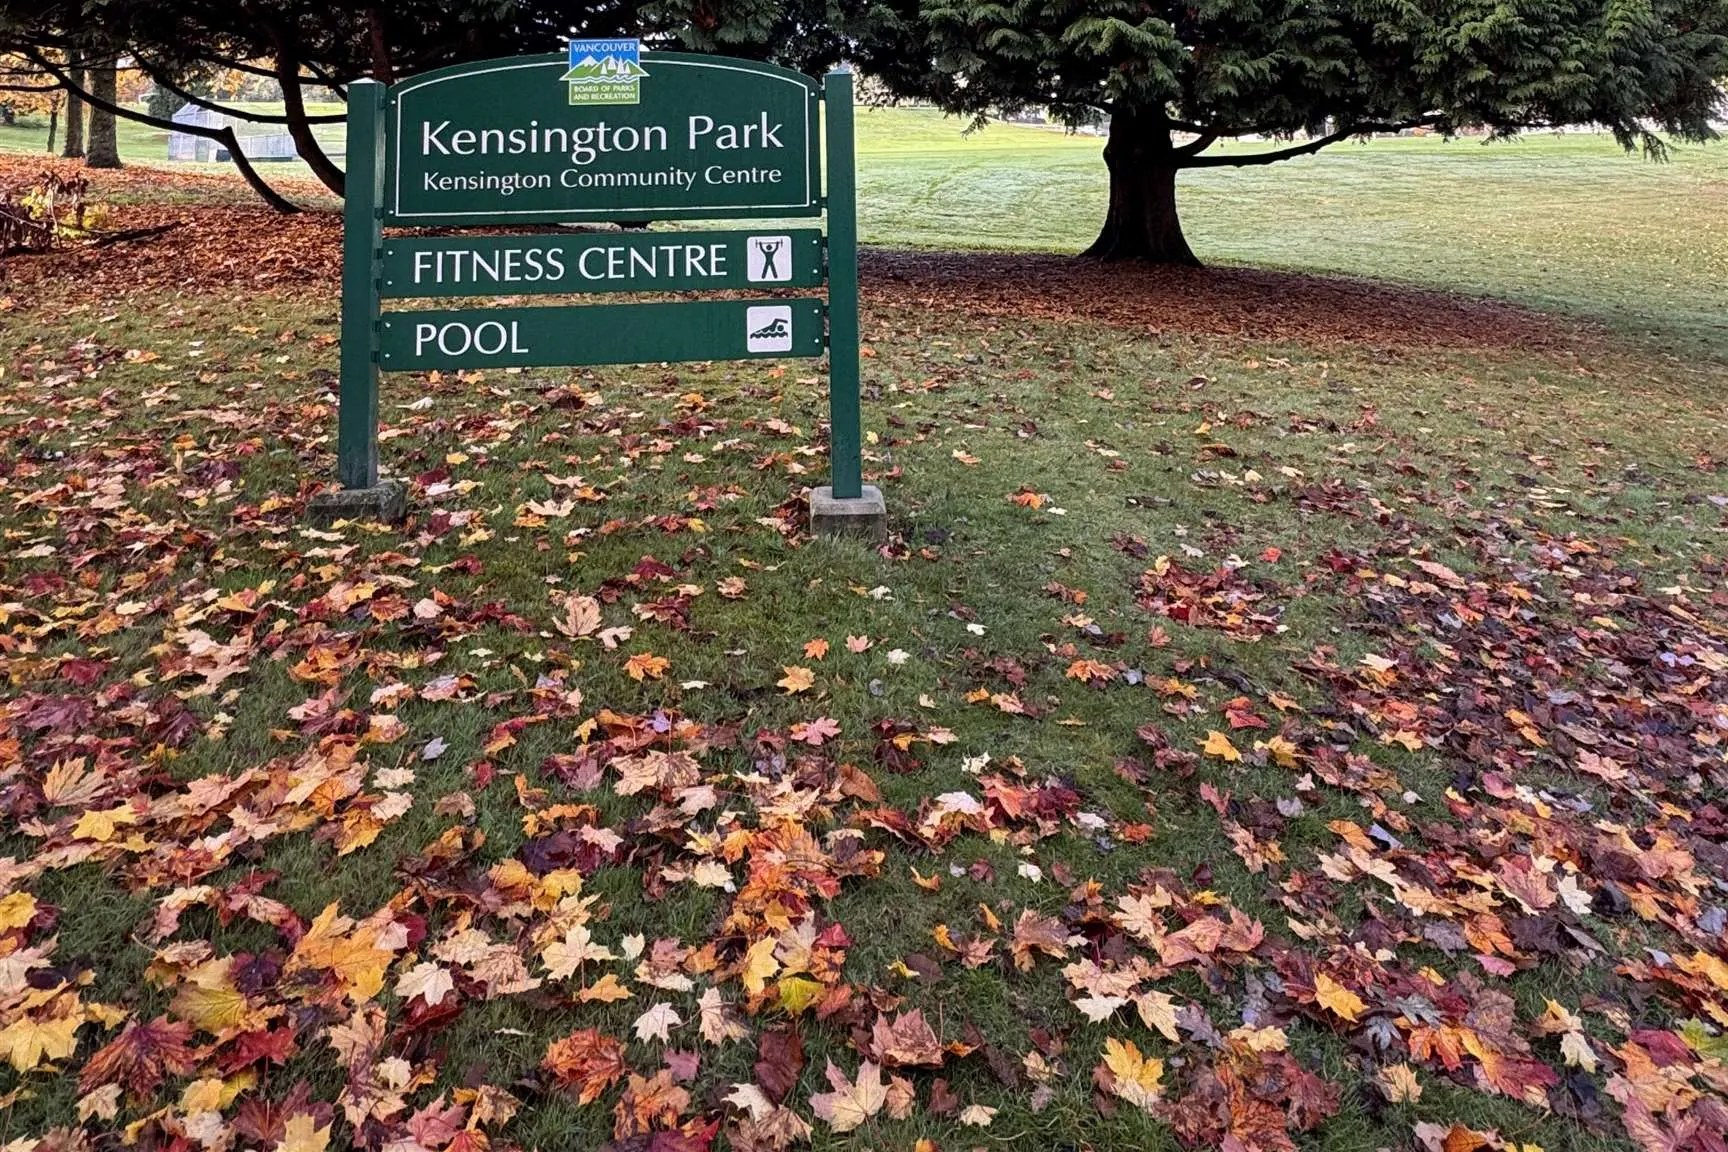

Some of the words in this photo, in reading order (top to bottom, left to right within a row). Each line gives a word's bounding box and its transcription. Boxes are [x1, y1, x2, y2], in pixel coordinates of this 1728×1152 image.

[574, 43, 635, 52] VANCOUVER
[421, 119, 668, 166] Kensington
[688, 111, 785, 150] Park
[423, 170, 551, 195] Kensington
[560, 167, 697, 192] Community
[704, 164, 783, 186] Centre
[413, 247, 565, 284] FITNESS
[578, 243, 728, 280] CENTRE
[415, 320, 529, 357] POOL
